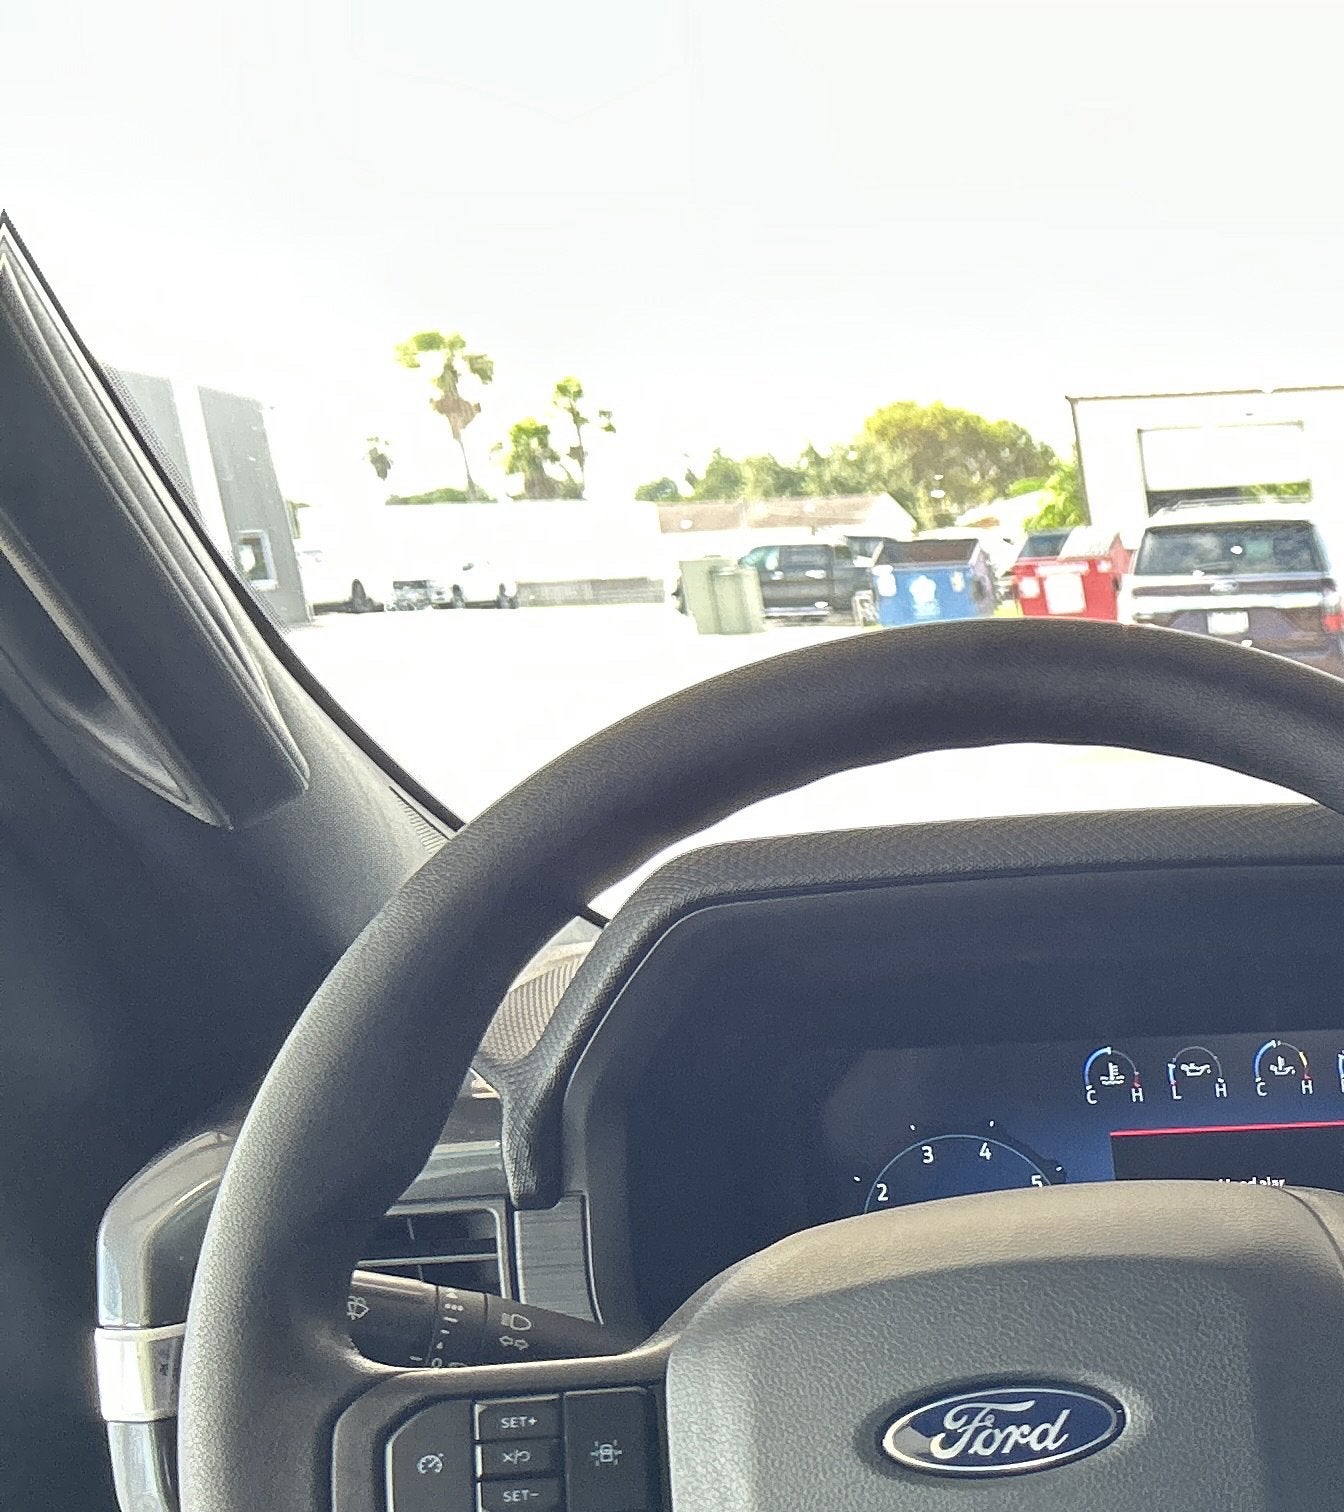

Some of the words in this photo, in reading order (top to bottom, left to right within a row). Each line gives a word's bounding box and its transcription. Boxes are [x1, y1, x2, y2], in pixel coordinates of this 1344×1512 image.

[1172, 1085, 1182, 1100] L
[1215, 1082, 1227, 1098] H
[1256, 1081, 1267, 1096] C
[1301, 1079, 1313, 1094] H
[1086, 1089, 1097, 1104] C
[1131, 1087, 1143, 1102] H
[921, 1145, 934, 1163] 3
[979, 1142, 992, 1160] 4
[1031, 1174, 1043, 1187] 5
[876, 1183, 889, 1201] 2
[929, 1399, 1071, 1460] Ford
